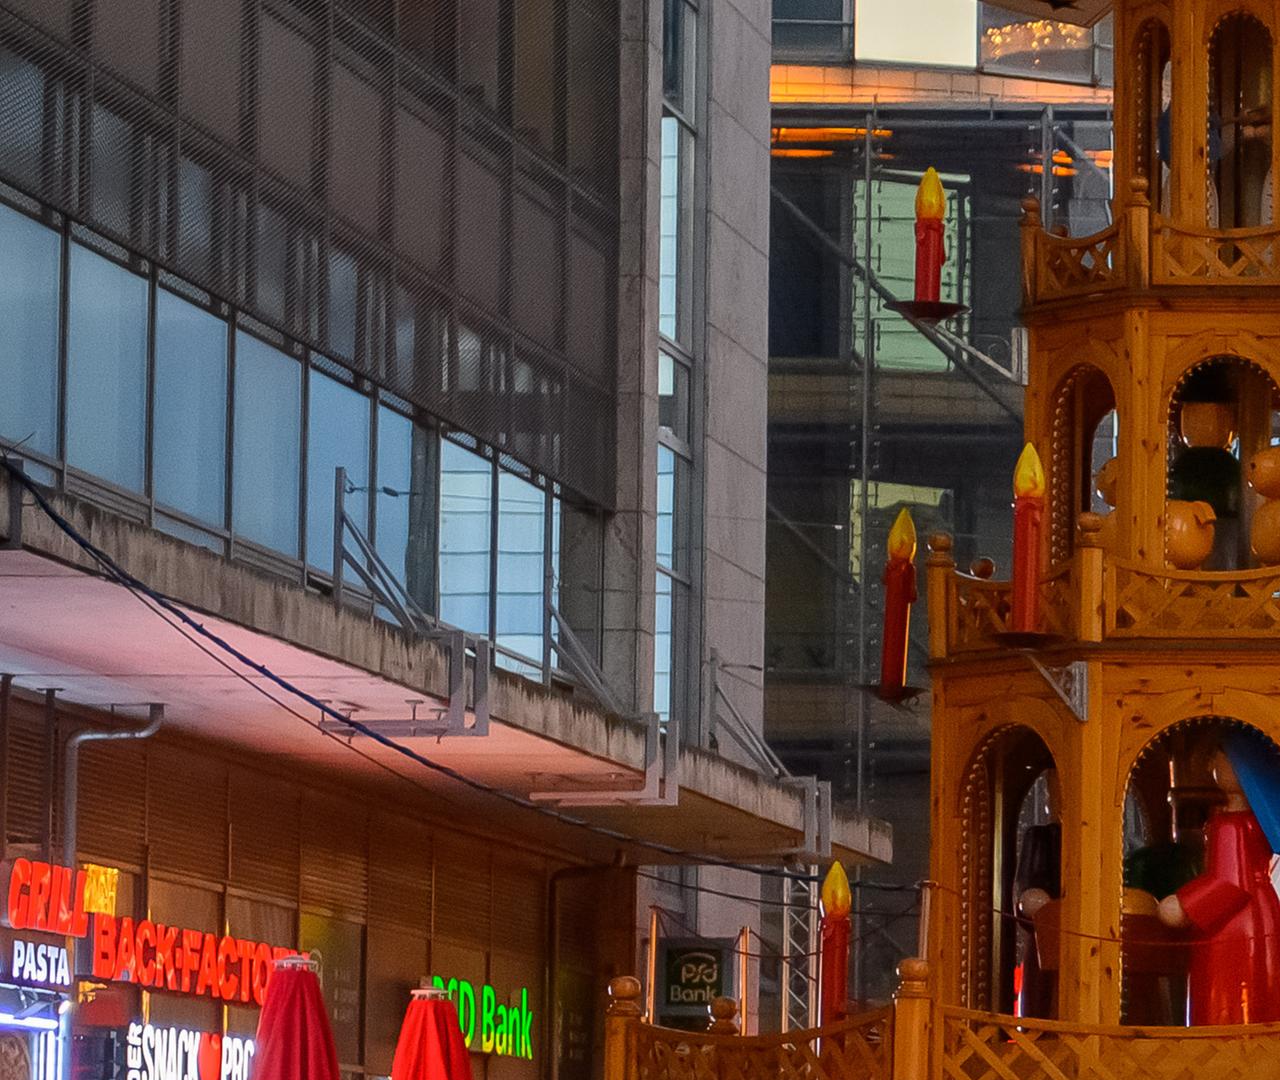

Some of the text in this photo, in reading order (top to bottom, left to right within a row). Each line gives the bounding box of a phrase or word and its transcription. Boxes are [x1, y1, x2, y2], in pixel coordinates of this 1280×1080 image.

[8, 857, 88, 938] GRILL
[12, 939, 70, 986] PASTA
[92, 911, 310, 1007] BACK-FACTO
[670, 984, 717, 1002] Bank
[482, 984, 533, 1060] Bank
